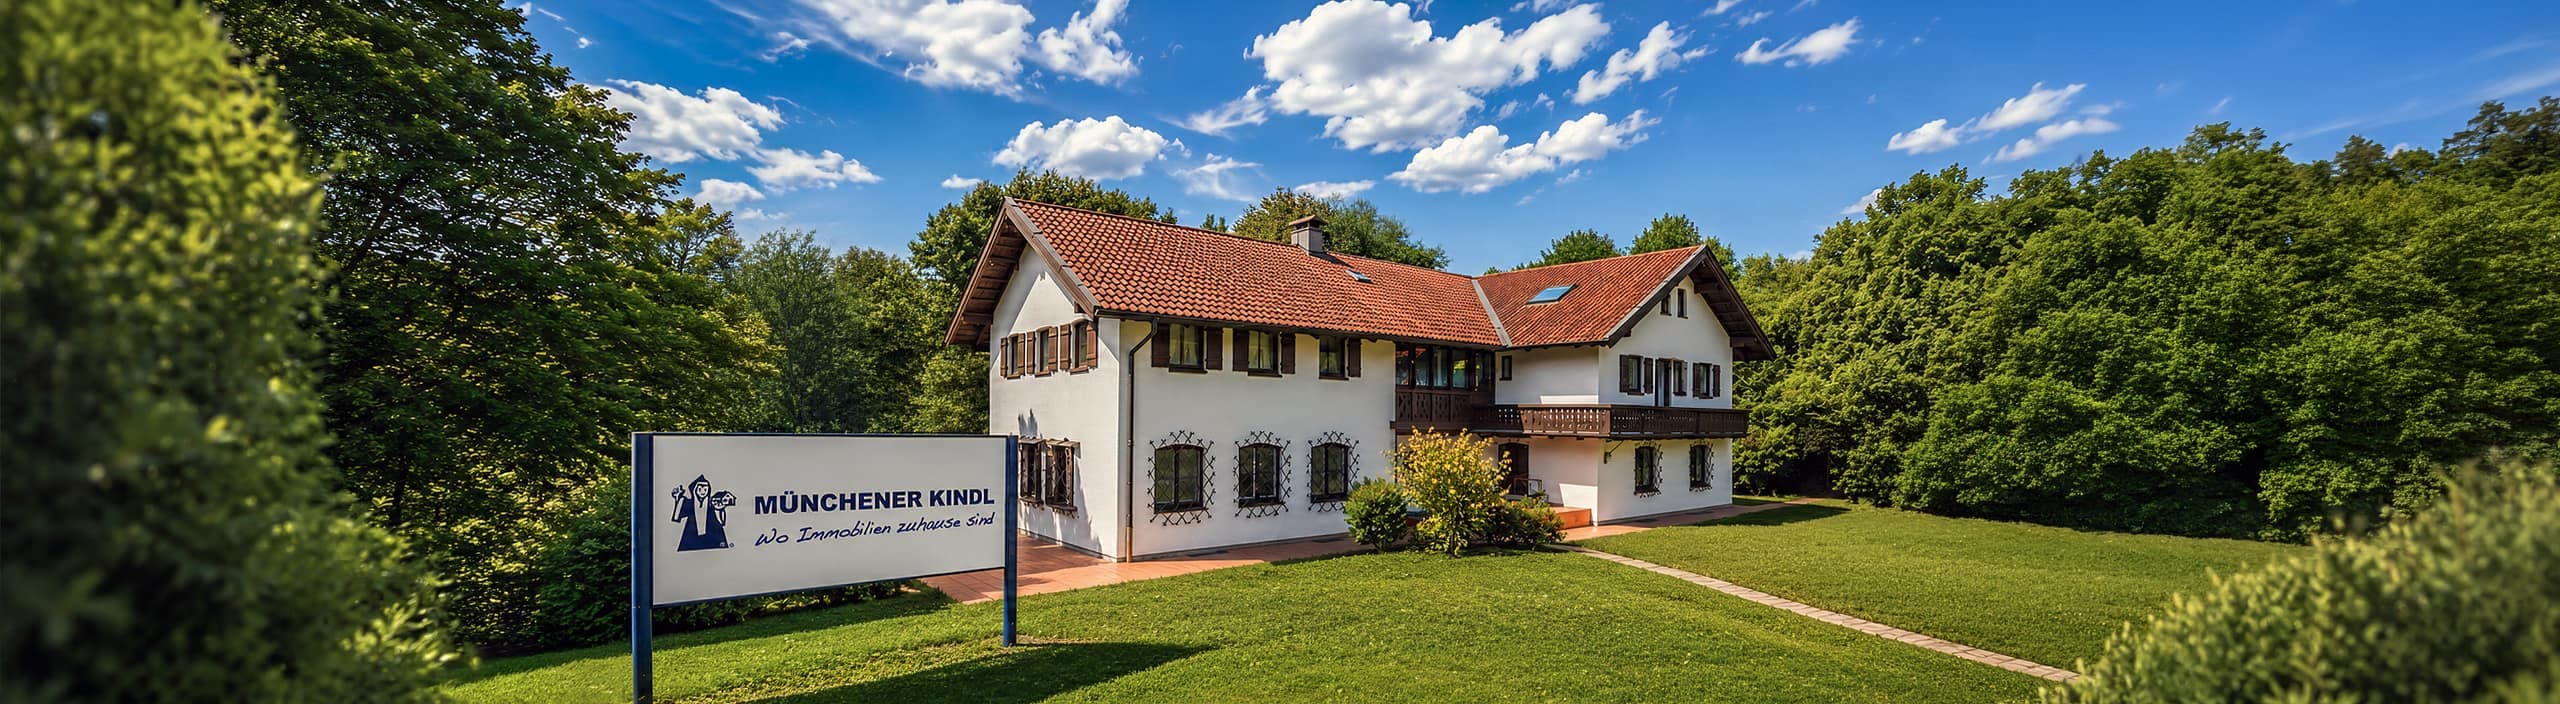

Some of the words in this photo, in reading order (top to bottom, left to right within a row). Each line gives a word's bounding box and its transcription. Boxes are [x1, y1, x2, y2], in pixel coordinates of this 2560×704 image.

[754, 490, 923, 515] MÜNCHENER
[929, 488, 995, 507] KINDL
[754, 527, 790, 547] Wo
[796, 520, 892, 543] Immobilien
[897, 516, 962, 534] zuhause
[965, 511, 996, 527] sind
